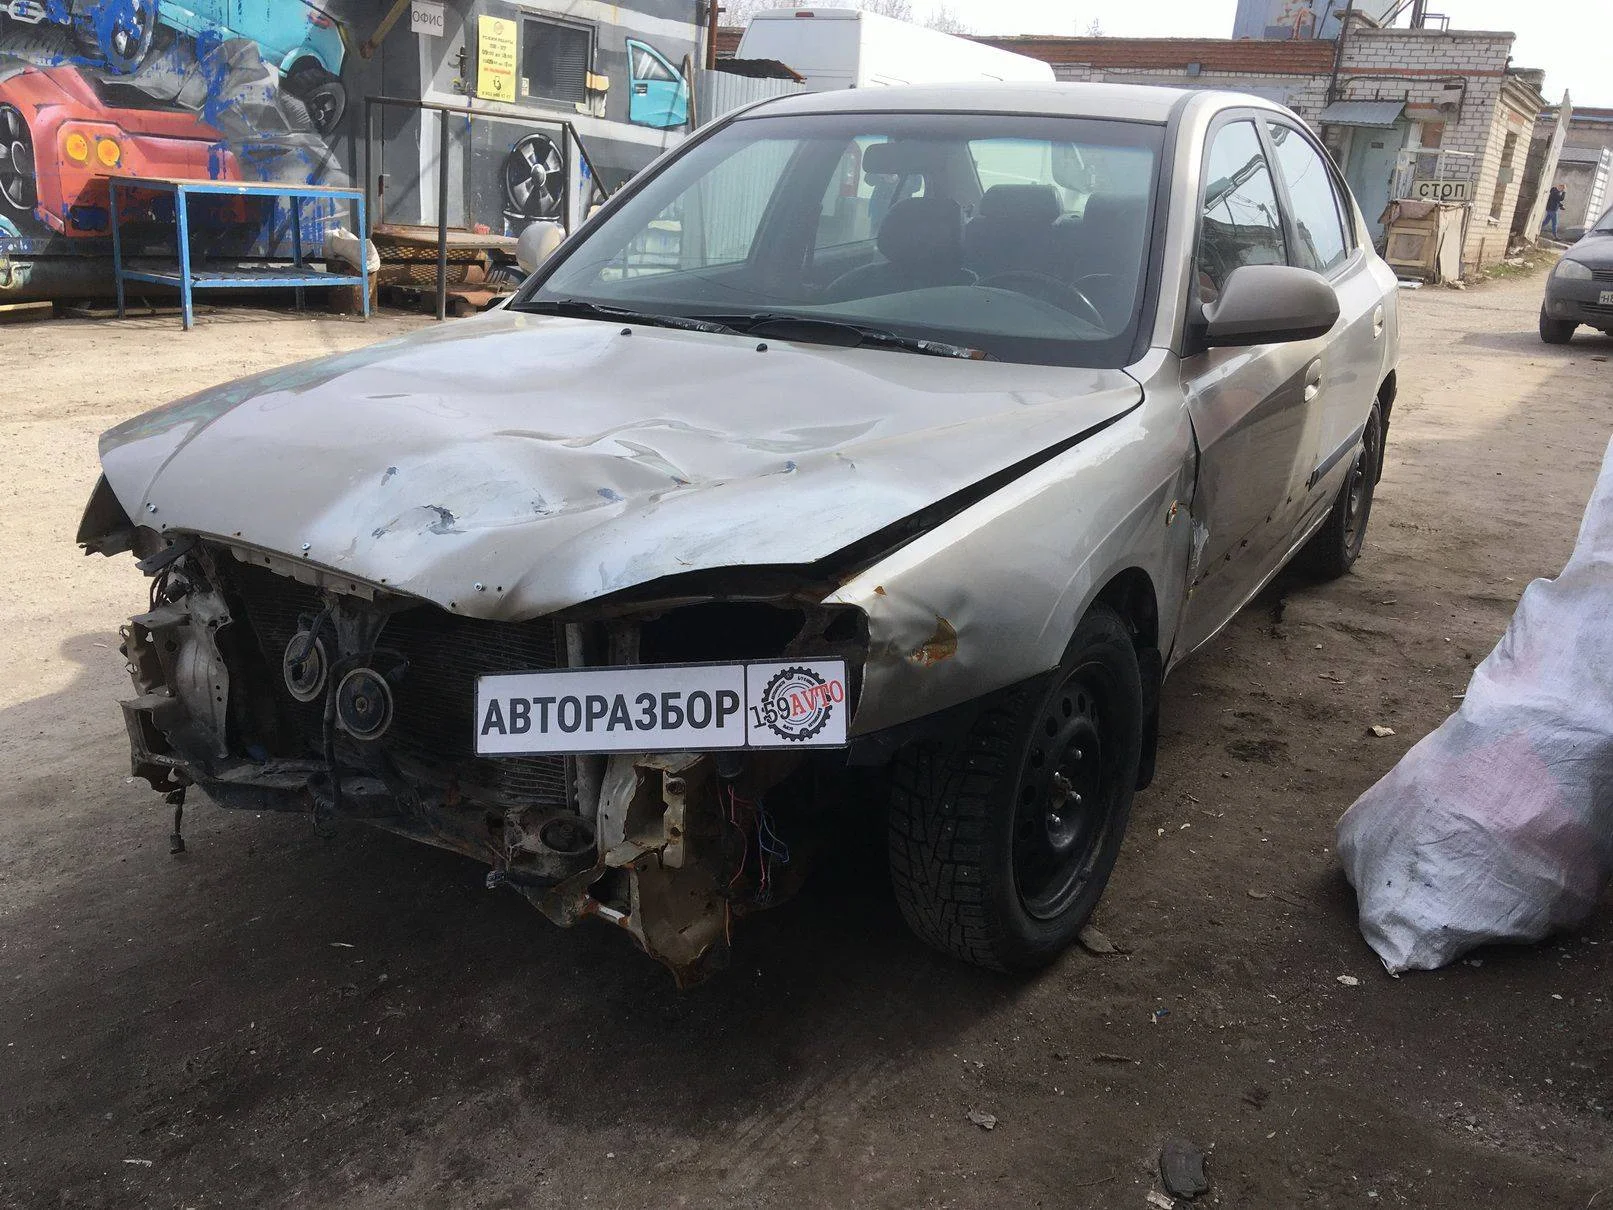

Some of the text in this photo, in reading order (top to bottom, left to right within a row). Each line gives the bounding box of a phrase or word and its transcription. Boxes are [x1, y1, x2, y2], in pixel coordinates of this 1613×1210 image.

[412, 10, 443, 27] ОФИС
[1420, 183, 1465, 197] СТОП
[480, 689, 740, 735] АВТОРАЗБОР
